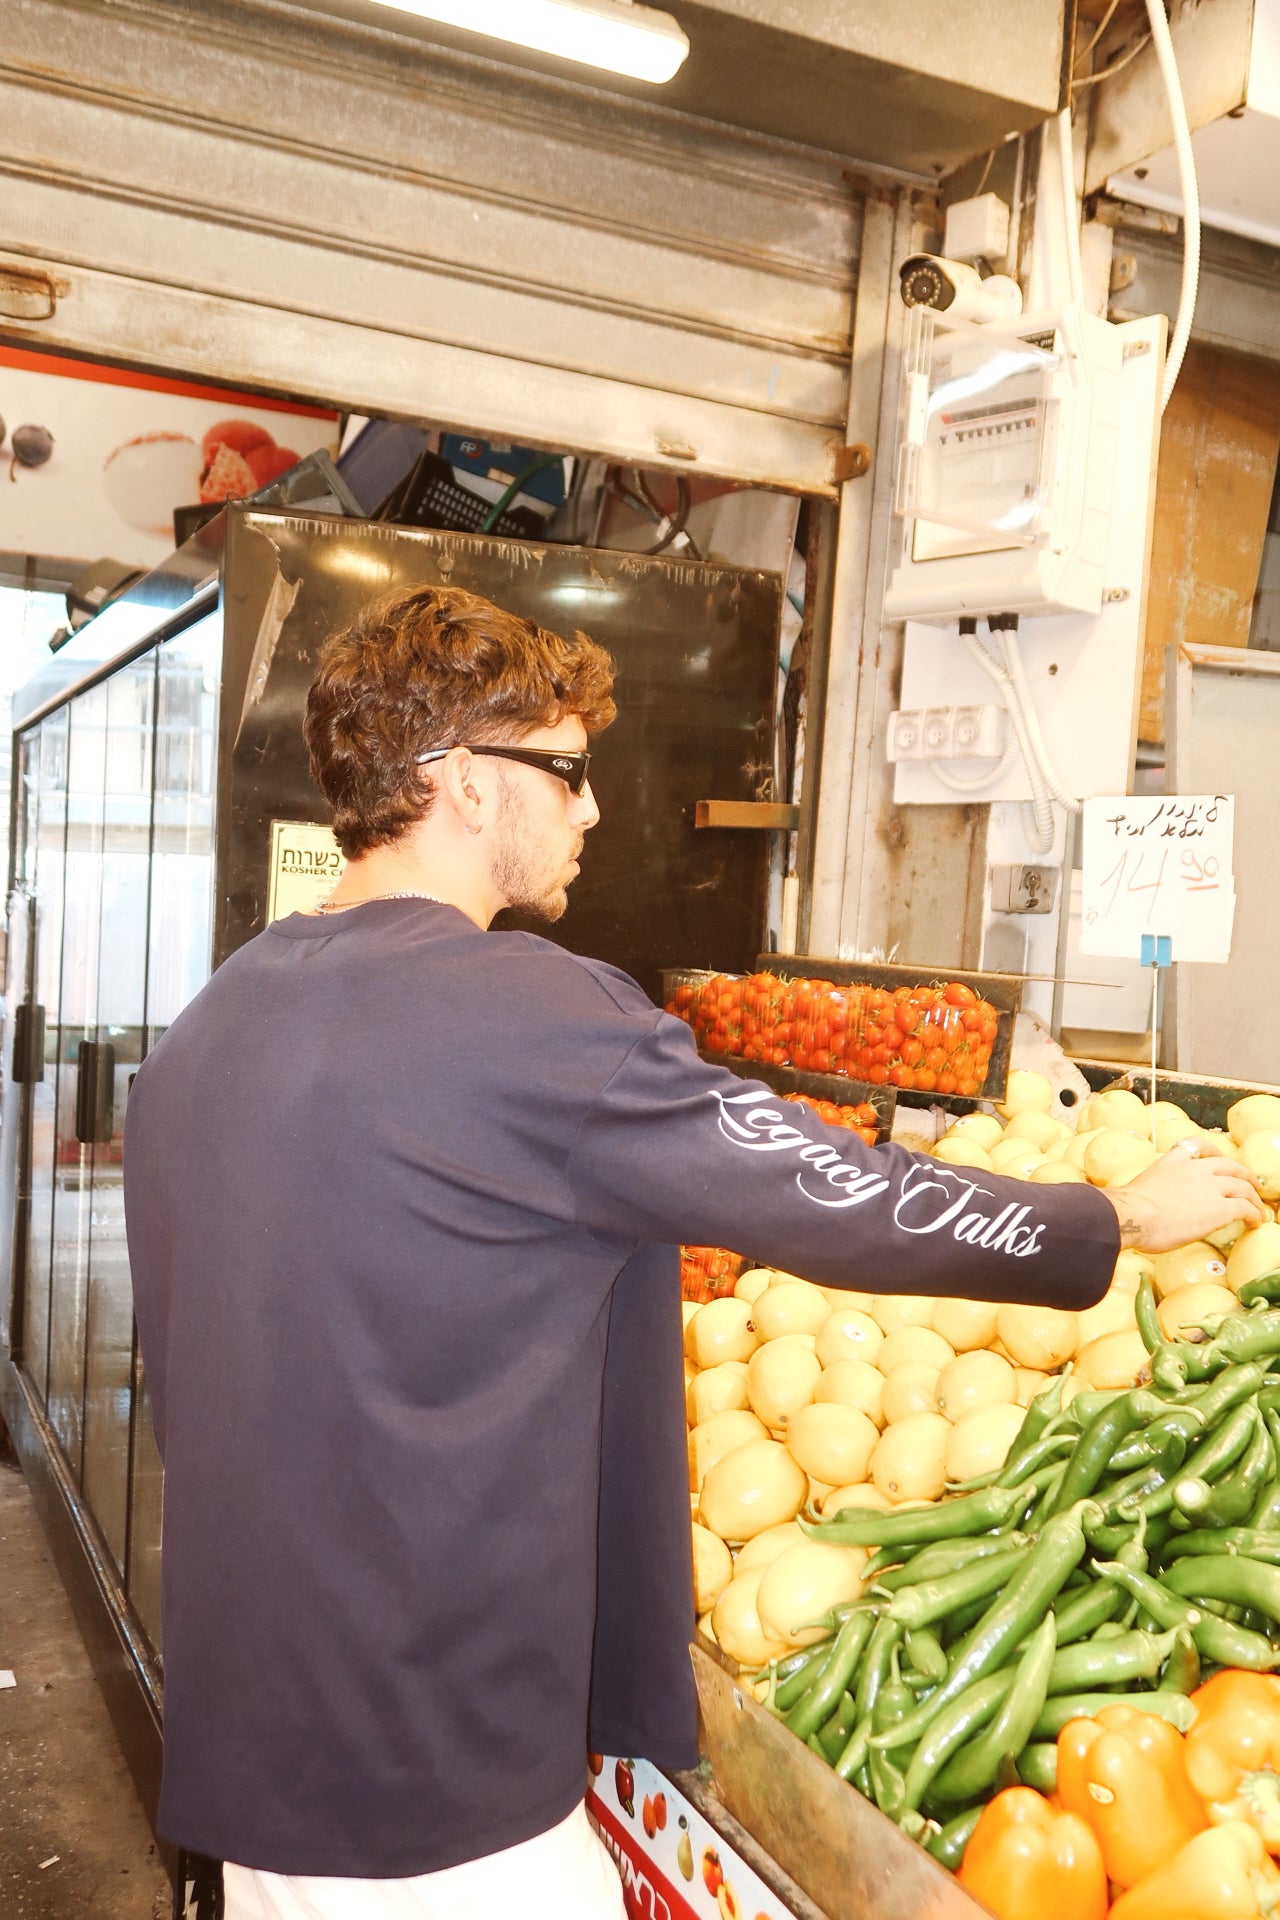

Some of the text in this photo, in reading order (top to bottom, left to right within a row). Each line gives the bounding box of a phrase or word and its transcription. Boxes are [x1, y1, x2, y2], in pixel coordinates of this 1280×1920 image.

[281, 849, 340, 868] כשרות
[281, 866, 327, 876] KOSHER
[1100, 848, 1219, 923] 14 90
[707, 1090, 1047, 1258] Legacy Talks
